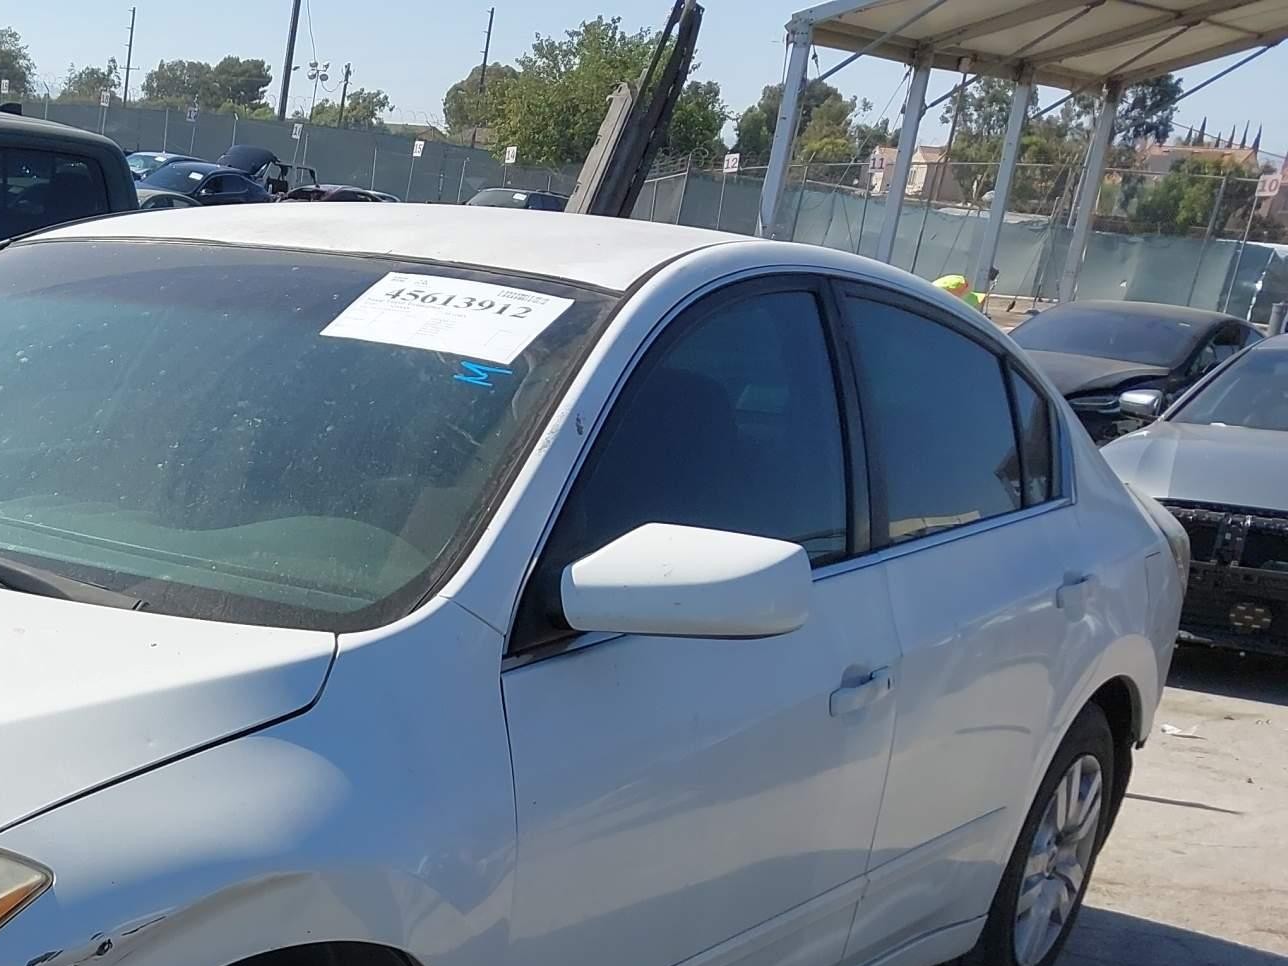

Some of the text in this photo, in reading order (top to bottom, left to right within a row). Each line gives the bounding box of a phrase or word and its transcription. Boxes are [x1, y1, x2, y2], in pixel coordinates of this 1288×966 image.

[725, 157, 738, 169] 12
[870, 157, 885, 170] 11
[1257, 178, 1279, 193] 10
[385, 287, 533, 319] 45613912
